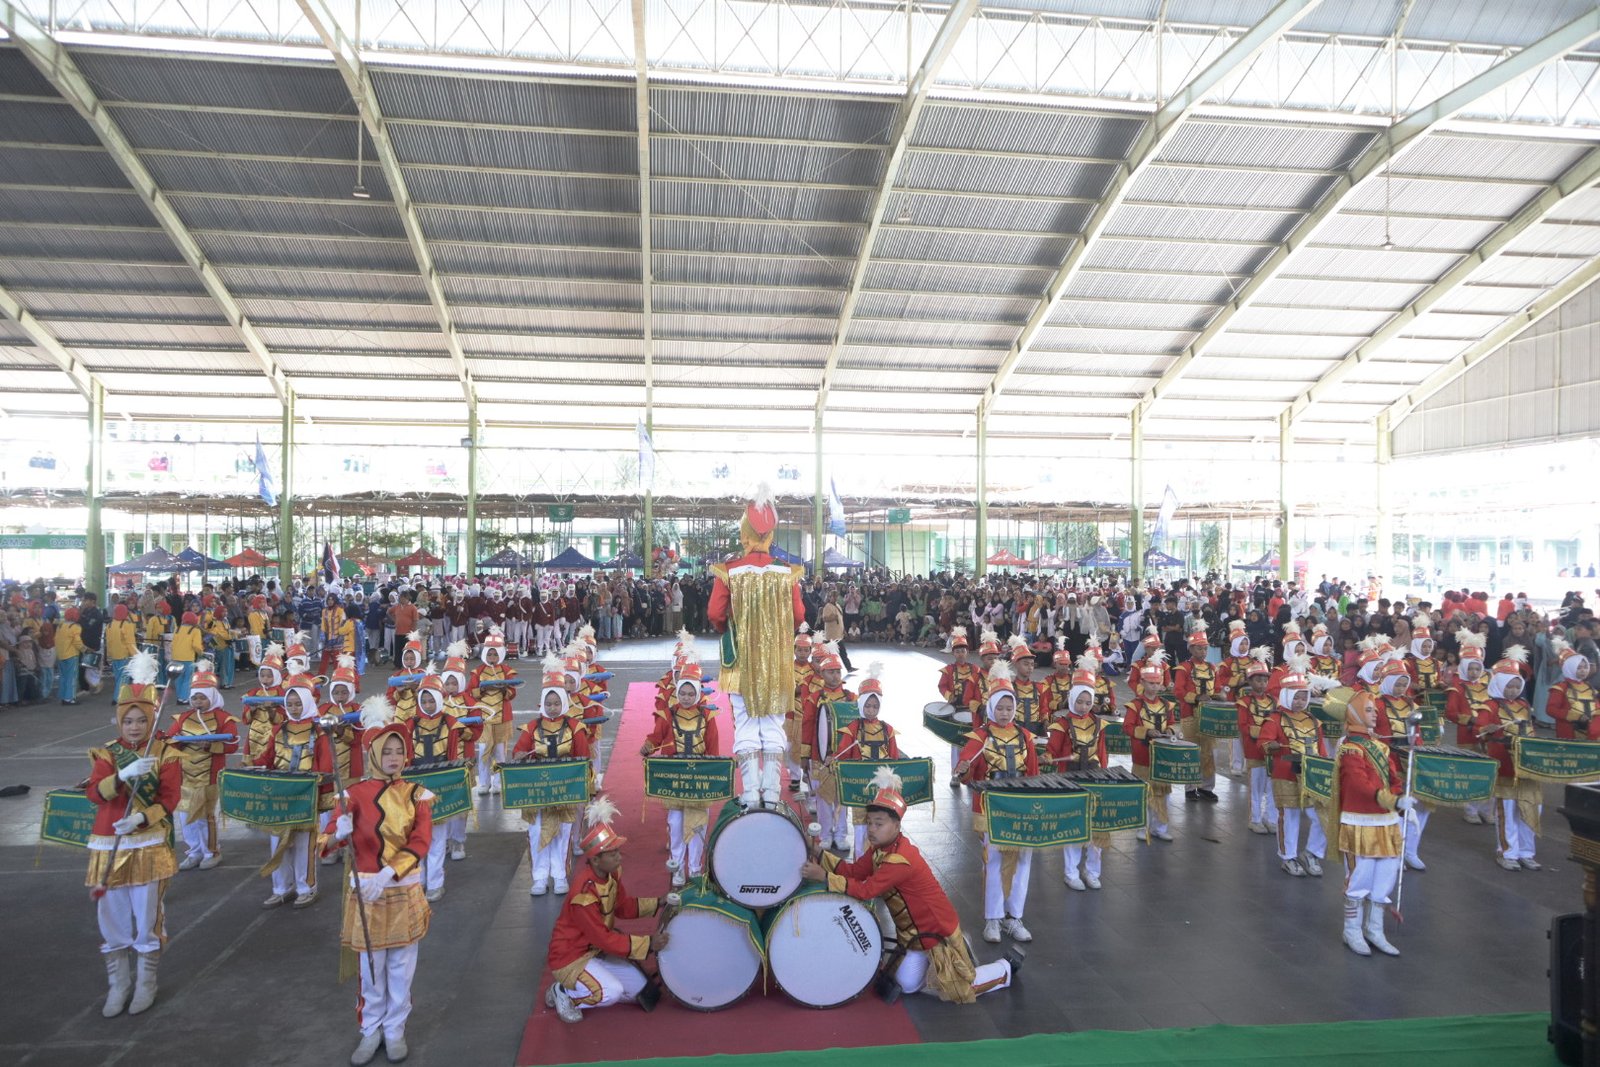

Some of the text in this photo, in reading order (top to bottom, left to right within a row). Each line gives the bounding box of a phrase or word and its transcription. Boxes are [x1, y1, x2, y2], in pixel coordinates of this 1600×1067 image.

[0, 538, 87, 548] AMAT DATAN
[695, 781, 710, 790] NW
[552, 786, 567, 795] NW
[657, 789, 676, 797] KOTA
[513, 798, 534, 806] KOTA
[272, 803, 288, 811] NW
[1102, 808, 1117, 817] NW
[1041, 821, 1058, 830] NW
[1000, 830, 1022, 841] KOTA
[1052, 828, 1081, 840] LOTIM
[739, 884, 781, 894] ROLLING
[839, 904, 872, 951] MAXTONE
